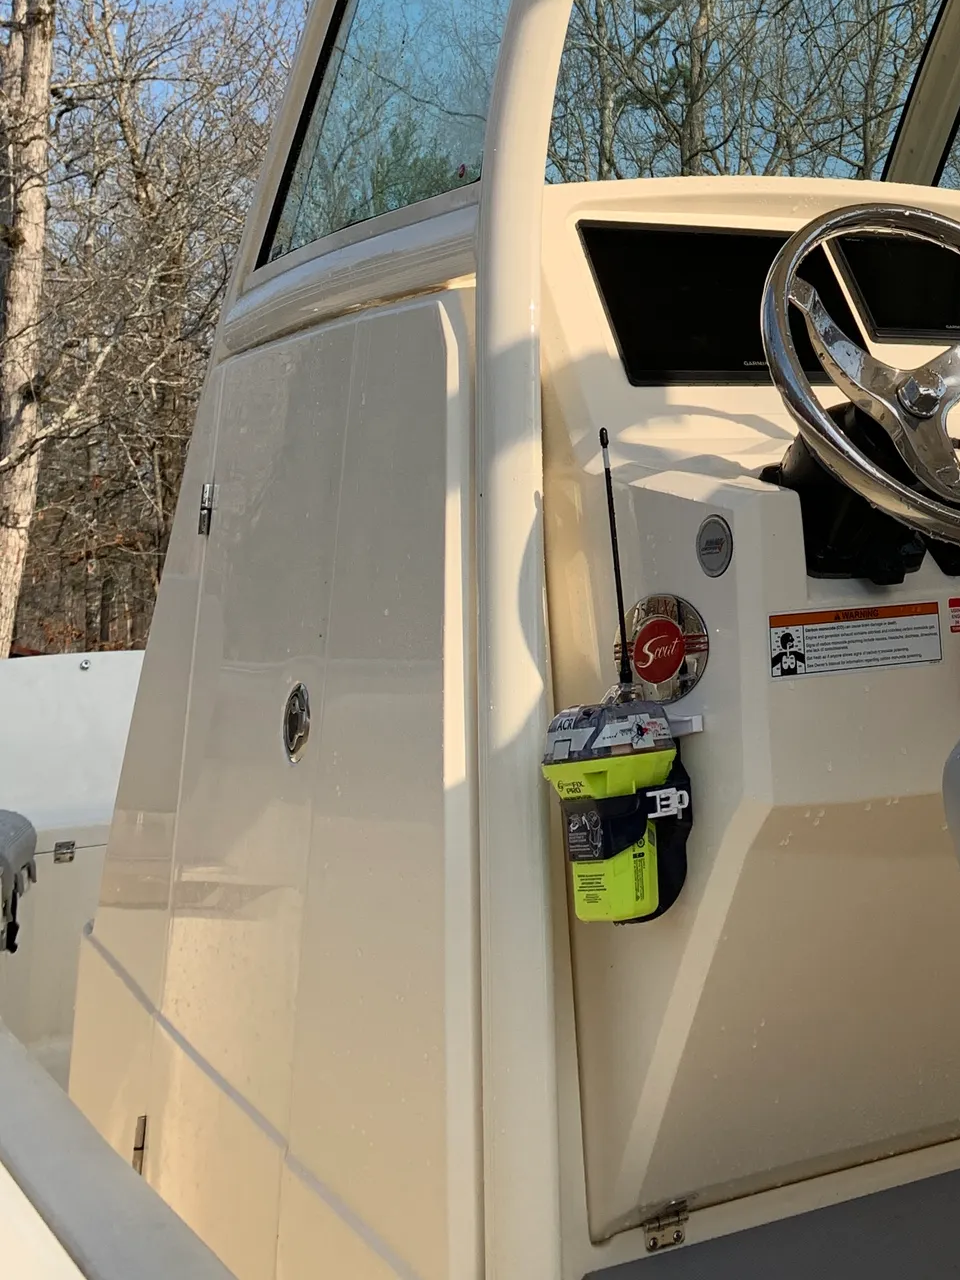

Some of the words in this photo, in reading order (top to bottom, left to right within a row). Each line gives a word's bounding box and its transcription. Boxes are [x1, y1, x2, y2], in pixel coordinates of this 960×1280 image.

[841, 609, 880, 620] WARNING
[637, 634, 683, 669] Scout
[557, 718, 574, 731] ACR
